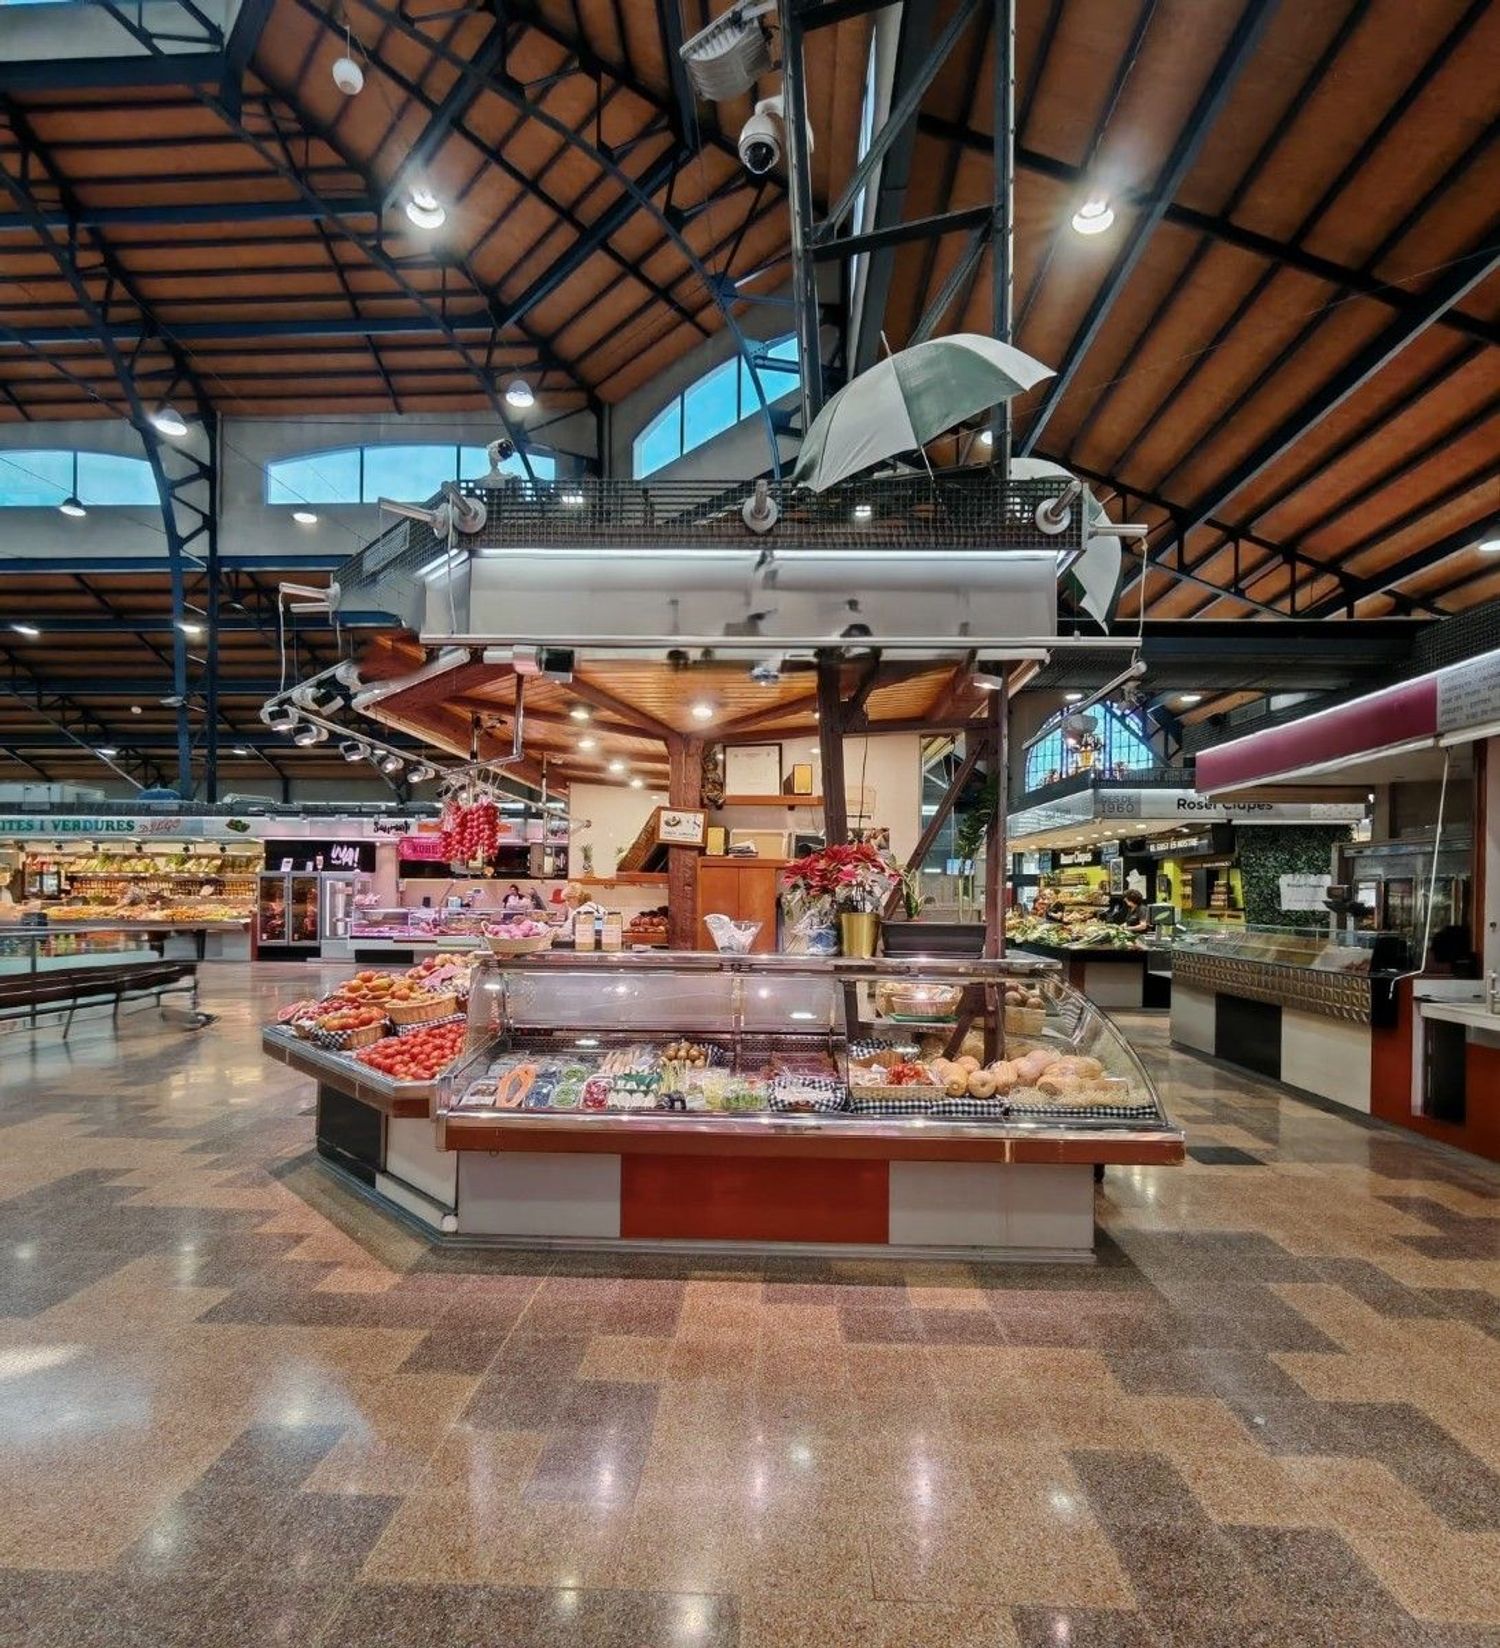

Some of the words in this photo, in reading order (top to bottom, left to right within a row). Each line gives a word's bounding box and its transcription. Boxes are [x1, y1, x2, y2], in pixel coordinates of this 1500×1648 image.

[1101, 803, 1135, 813] 1960
[1176, 798, 1217, 811] Roser
[38, 819, 45, 832] I
[51, 819, 135, 832] VERDURES
